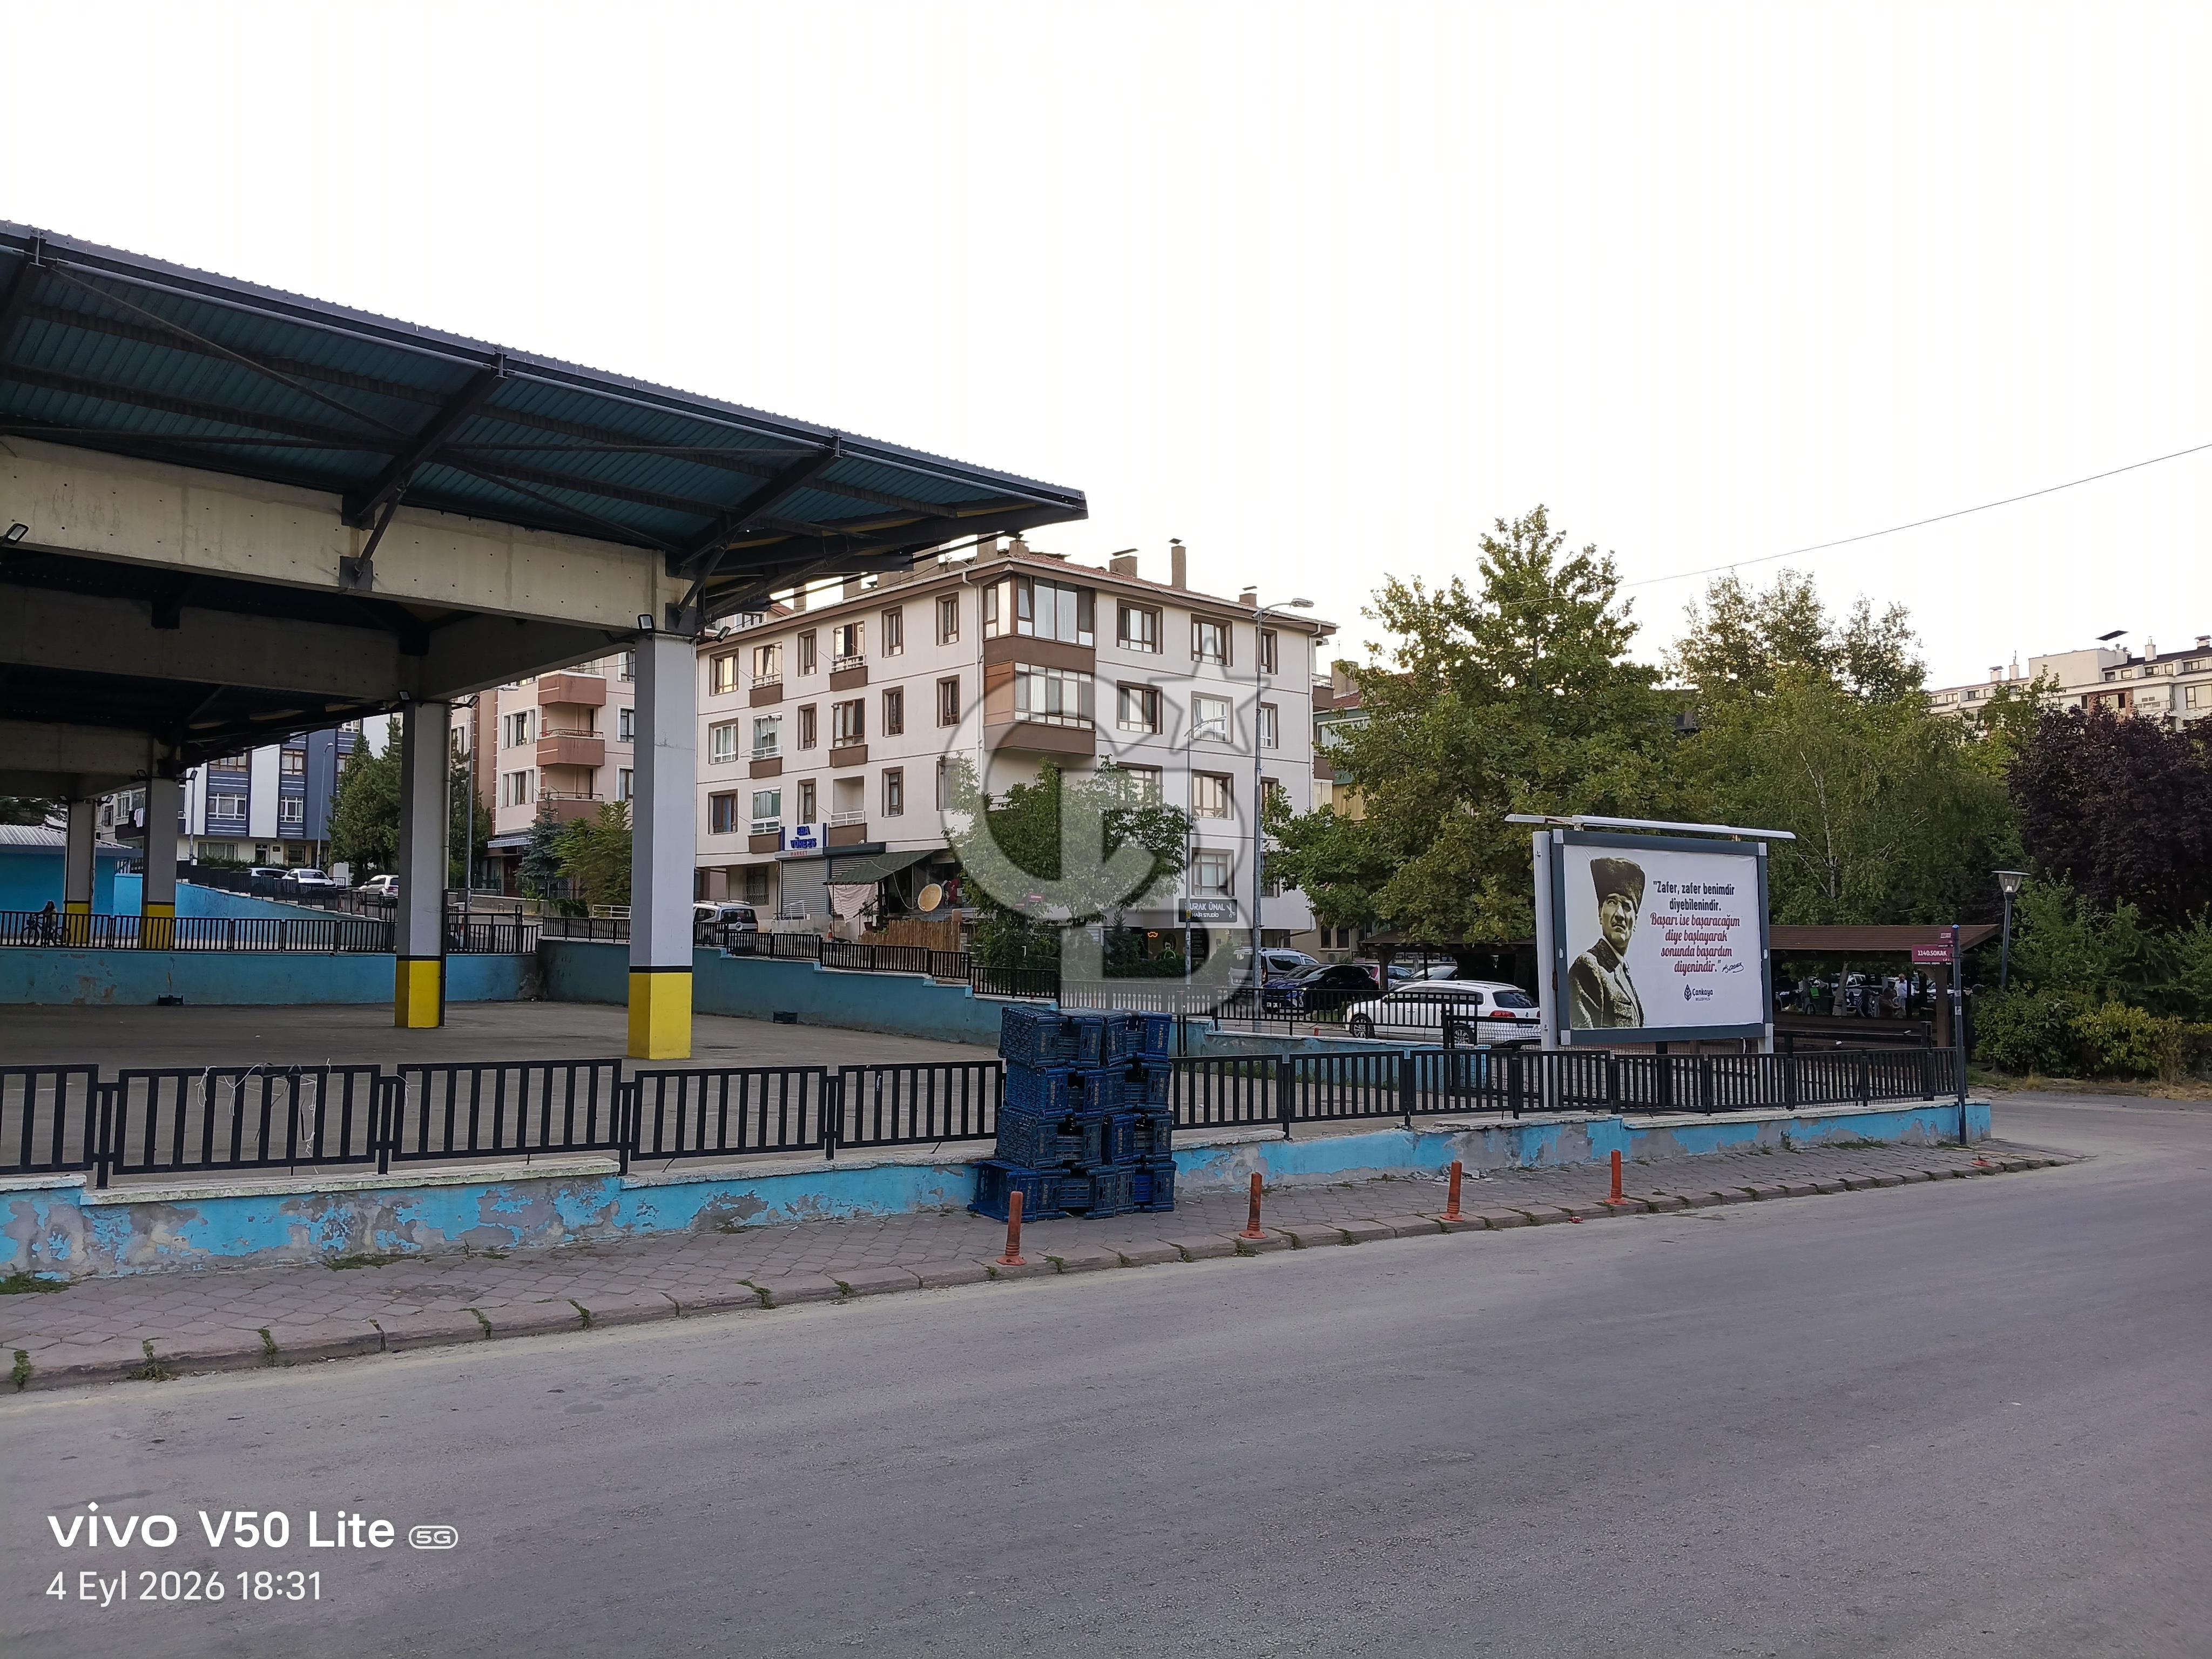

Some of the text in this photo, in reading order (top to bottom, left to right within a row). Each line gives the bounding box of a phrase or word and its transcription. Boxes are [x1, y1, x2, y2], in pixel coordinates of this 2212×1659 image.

[1653, 880, 1735, 895] "Zafer, zafer benimdir
[1185, 902, 1207, 911] URAK
[1669, 898, 1722, 913] diyebilenindir.
[1650, 912, 1740, 930] Başarı ise başaracağım
[1665, 929, 1728, 945] diye başlayarak
[1661, 945, 1732, 960] sonunda başardım
[1674, 959, 1721, 976] diyenindir."
[1692, 988, 1713, 996] Çankaya
